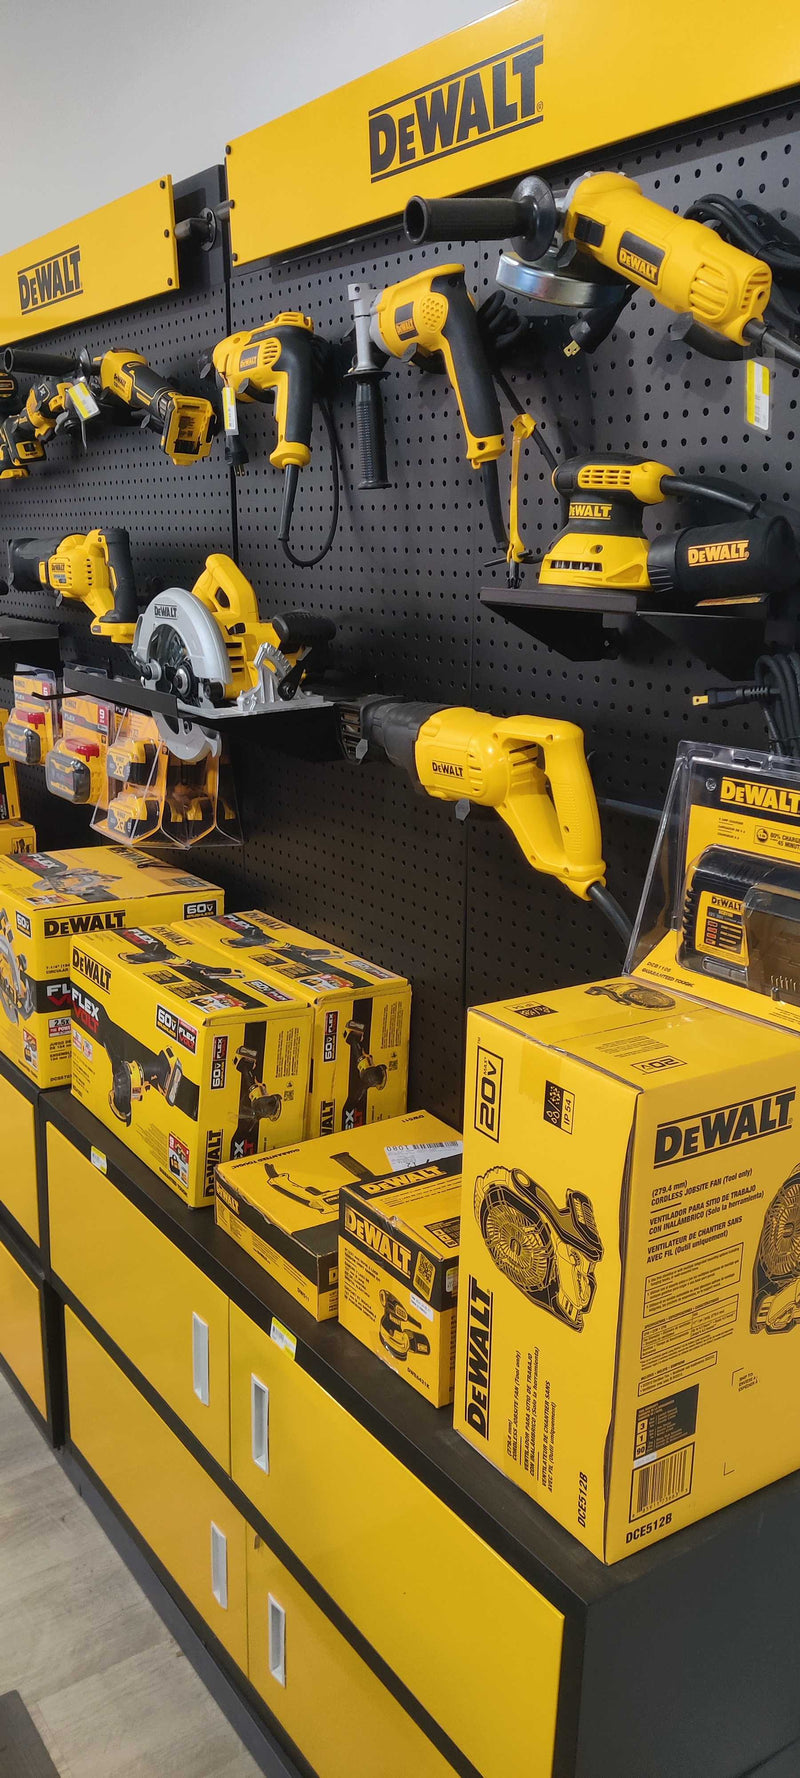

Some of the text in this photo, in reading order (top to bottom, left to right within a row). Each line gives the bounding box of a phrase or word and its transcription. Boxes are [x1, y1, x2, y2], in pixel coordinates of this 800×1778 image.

[654, 1091, 795, 1165] DEWALT
[650, 1184, 757, 1226] VENTILADOR PARA SITIO DE TRABAJO
[651, 1168, 753, 1206] CORDLESS JOBSITE FAN (Tool only)
[673, 1179, 688, 1192] mm)
[649, 1224, 662, 1235] CON
[728, 1190, 765, 1209] herramienta)
[647, 1215, 743, 1255] VENTILATEUR DE CHANTIER SANS
[646, 1253, 663, 1264] AVEC
[664, 1248, 674, 1257] FIL
[467, 1277, 492, 1438] DEWALT
[636, 1446, 645, 1455] 90
[577, 1471, 589, 1529] DCE512B
[625, 1512, 673, 1544] DCE512B
